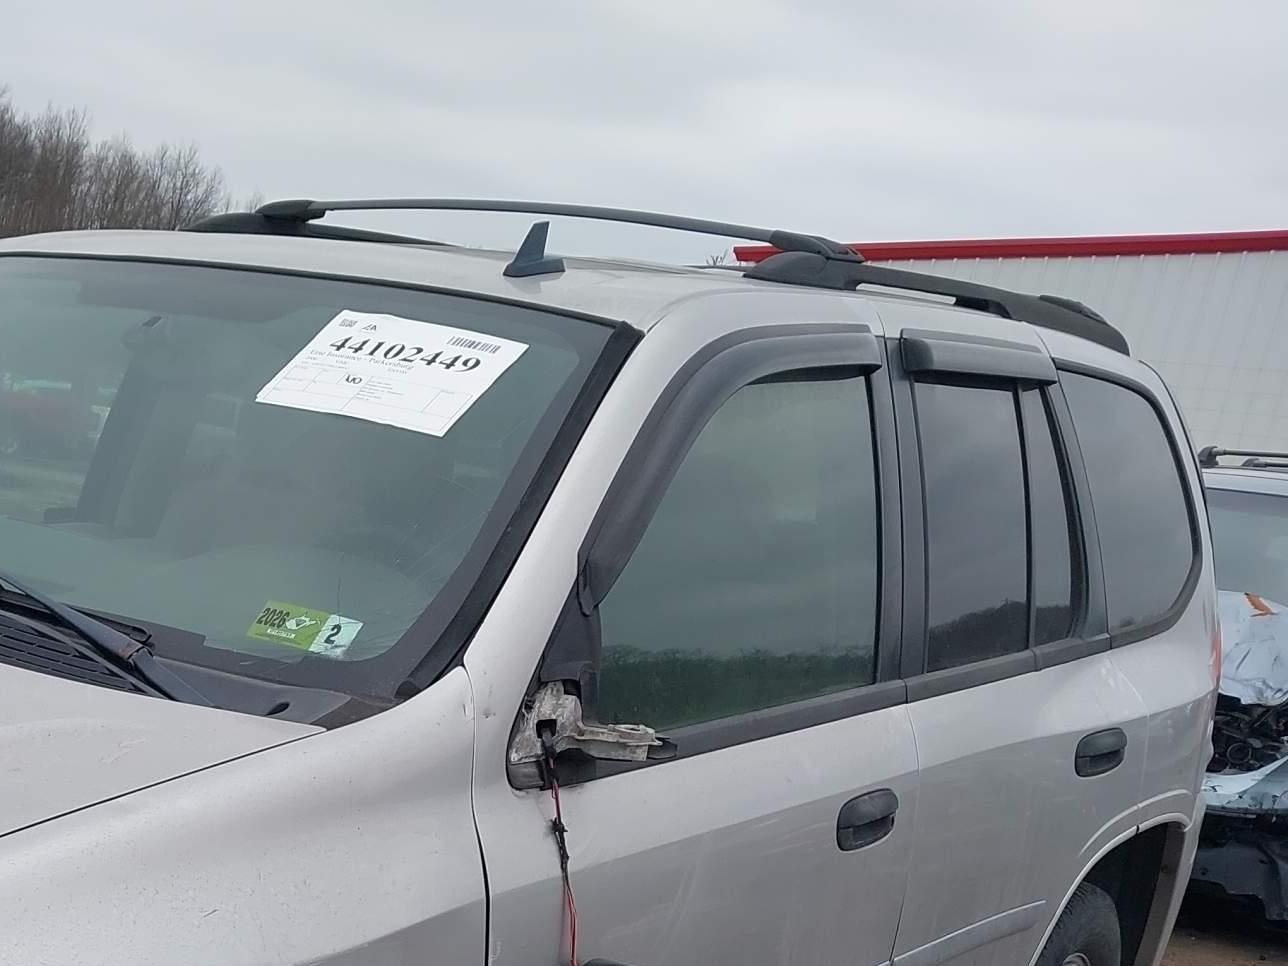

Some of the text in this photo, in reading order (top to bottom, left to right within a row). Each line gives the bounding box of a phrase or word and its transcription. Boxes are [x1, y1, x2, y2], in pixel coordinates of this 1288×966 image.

[329, 335, 482, 373] 44102449
[256, 607, 291, 628] 2026
[324, 623, 342, 644] 2
